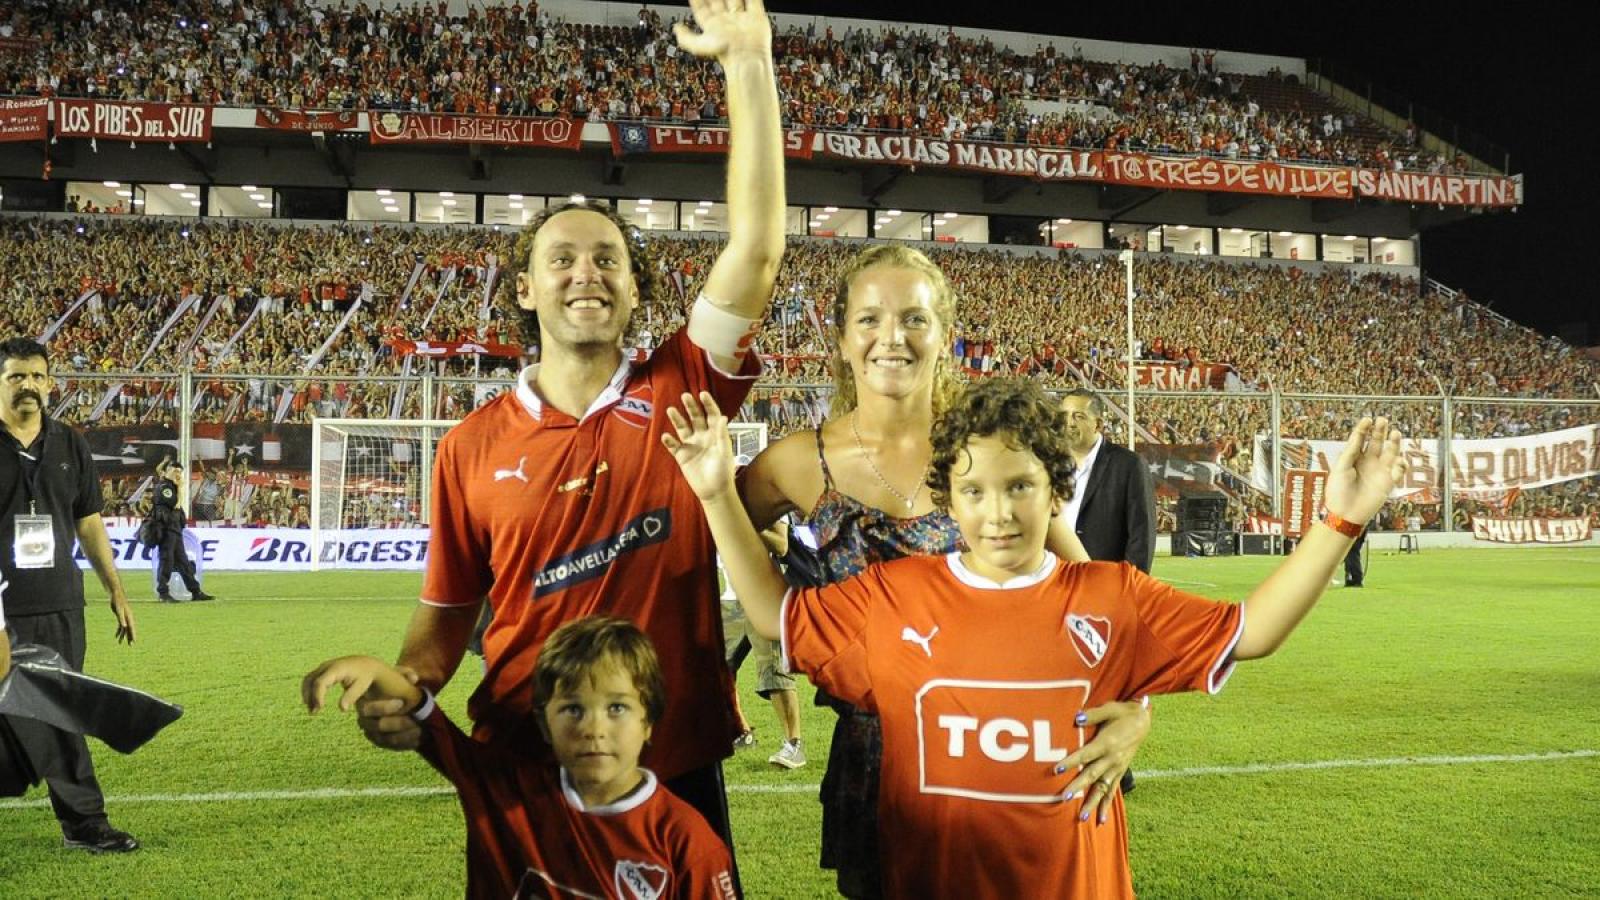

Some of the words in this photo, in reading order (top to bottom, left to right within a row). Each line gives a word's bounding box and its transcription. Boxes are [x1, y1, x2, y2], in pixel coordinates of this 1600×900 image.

[60, 102, 90, 133] LOS
[94, 103, 143, 137] PIBES
[144, 119, 165, 137] DEL
[167, 107, 205, 138] SUR
[402, 115, 572, 143] ALBERTO
[826, 133, 950, 164] GRACIAS
[1223, 163, 1259, 189] DE
[1263, 166, 1349, 194] WILDE
[1503, 439, 1586, 485] OLIVOS
[937, 714, 1068, 762] TCL
